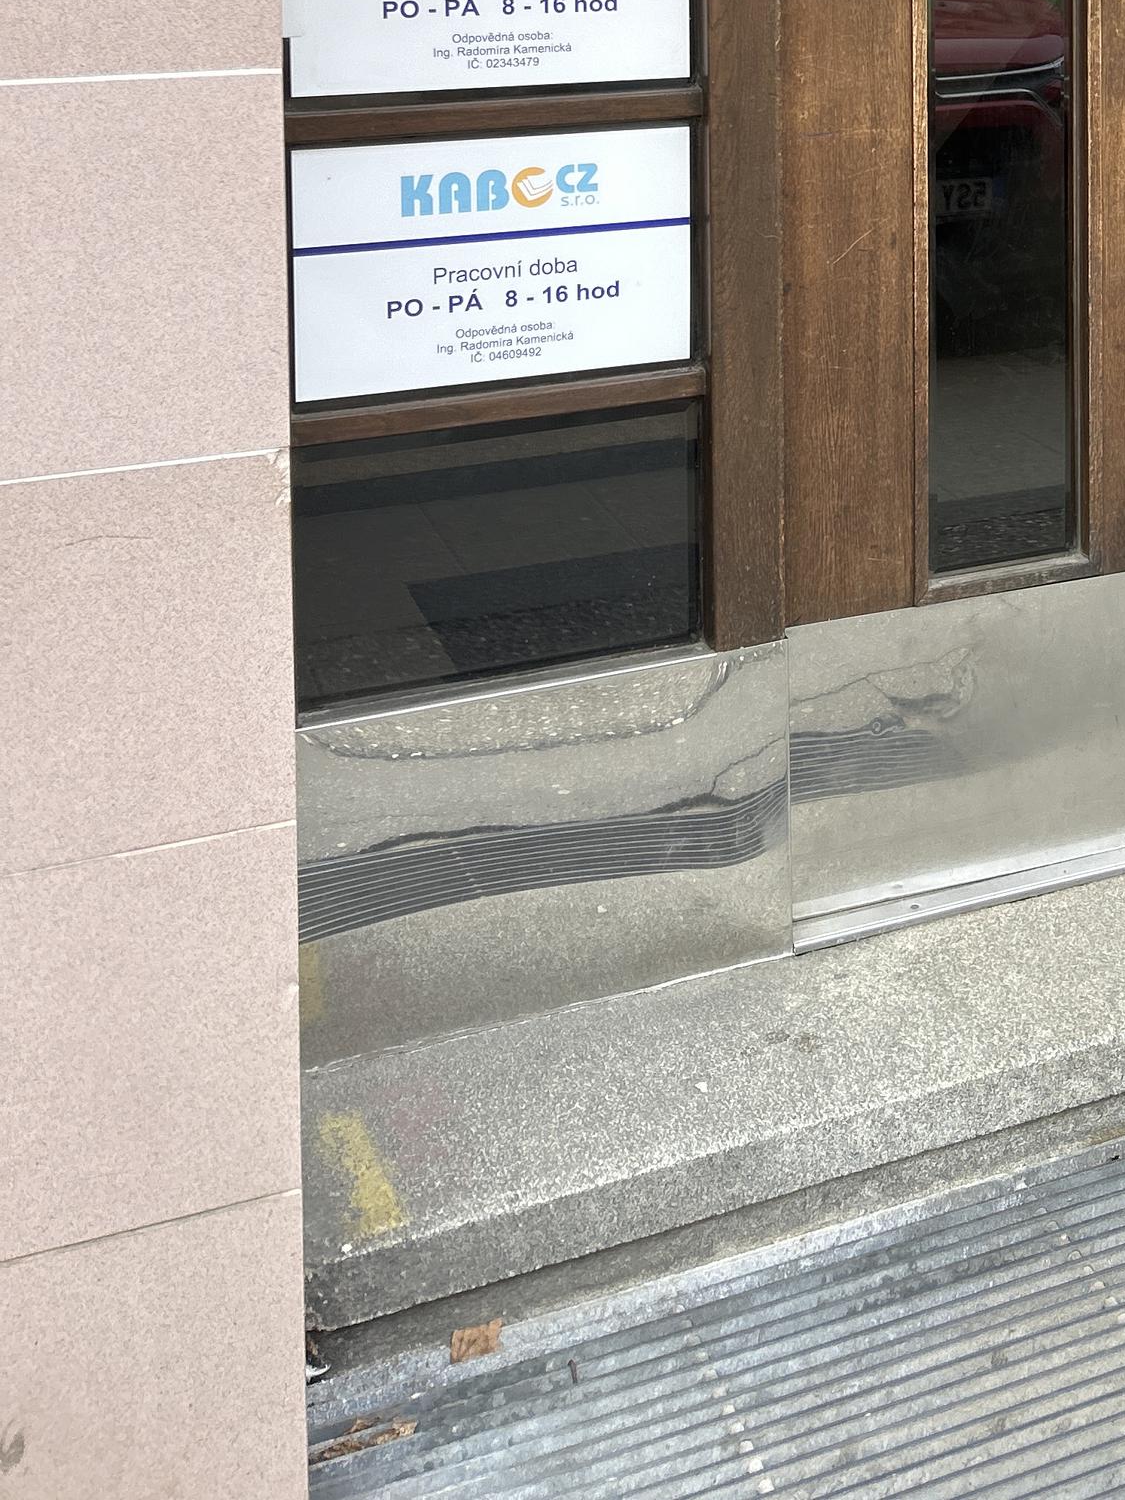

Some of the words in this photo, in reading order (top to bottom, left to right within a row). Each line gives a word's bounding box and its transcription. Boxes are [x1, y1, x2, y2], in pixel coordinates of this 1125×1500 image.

[382, 0, 420, 19] PO
[452, 31, 514, 44] Odpovědná
[433, 48, 453, 59] Ing.
[513, 42, 572, 54] Kamenická
[486, 56, 540, 68] 02343479
[556, 162, 599, 193] CZ
[561, 194, 600, 208] s.r.o.
[433, 260, 522, 285] Pracovní
[529, 257, 578, 277] doba
[386, 298, 424, 319] PO
[448, 288, 483, 313] PÁ
[505, 289, 518, 308] 8
[542, 285, 568, 304] 16
[577, 281, 620, 301] hod
[455, 323, 517, 339] Odpovědná
[437, 343, 456, 355] Ing.
[516, 330, 574, 346] Kamenická
[489, 347, 542, 361] 04609492
